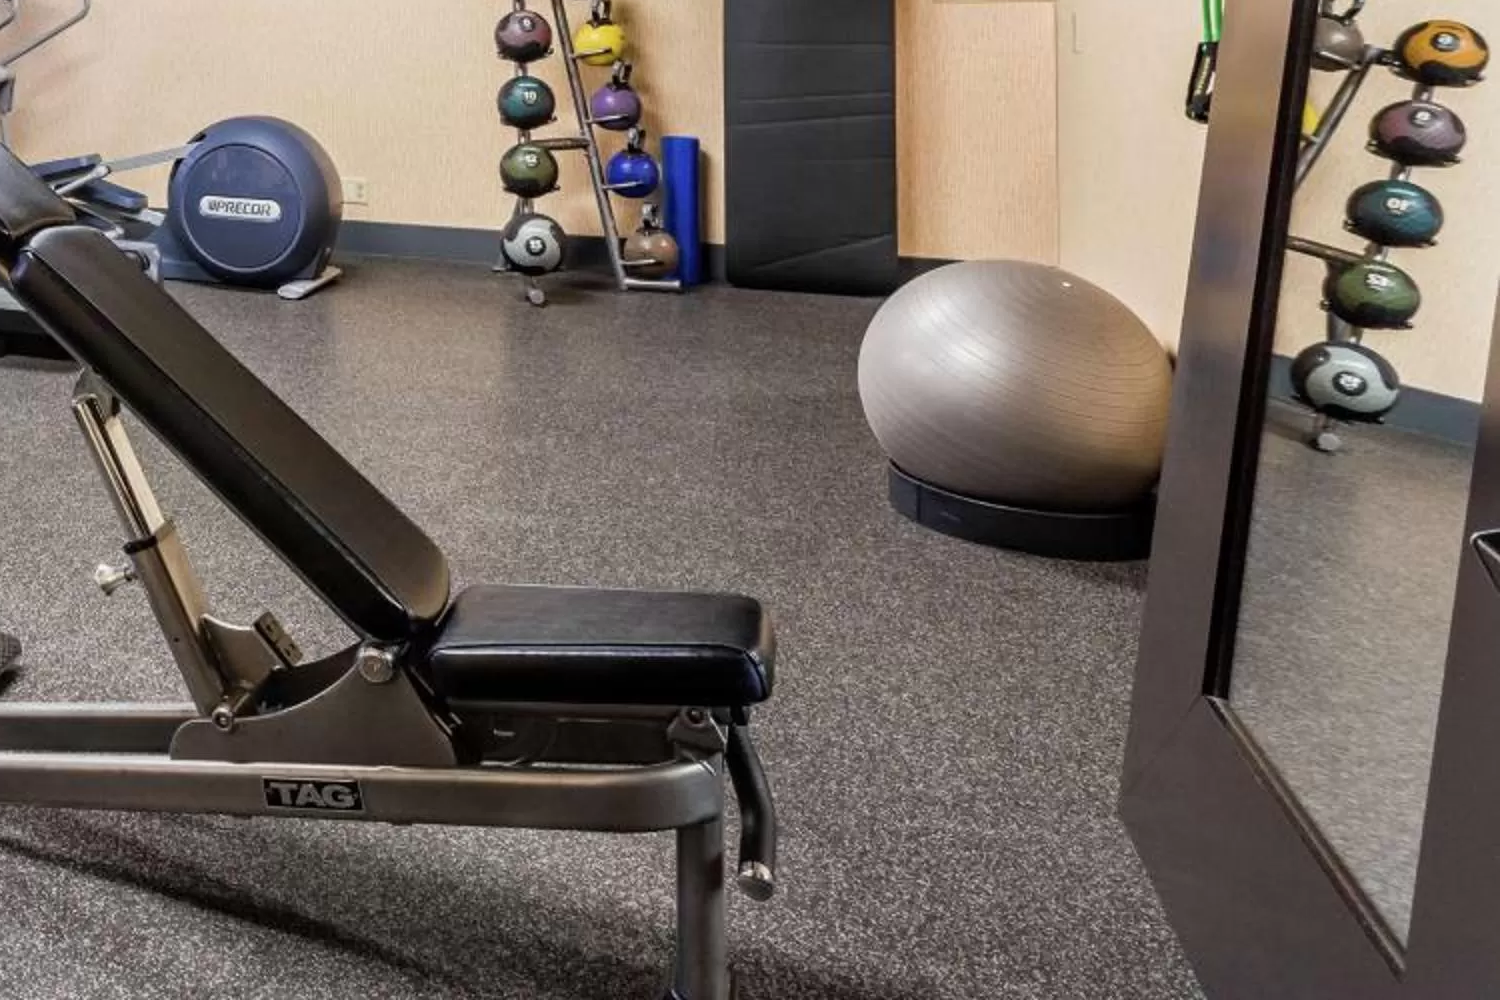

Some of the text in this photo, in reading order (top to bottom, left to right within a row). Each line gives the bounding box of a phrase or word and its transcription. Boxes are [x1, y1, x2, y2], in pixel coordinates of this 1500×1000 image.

[524, 90, 538, 101] 10
[215, 200, 272, 217] PRECOR
[269, 781, 355, 808] TAG
